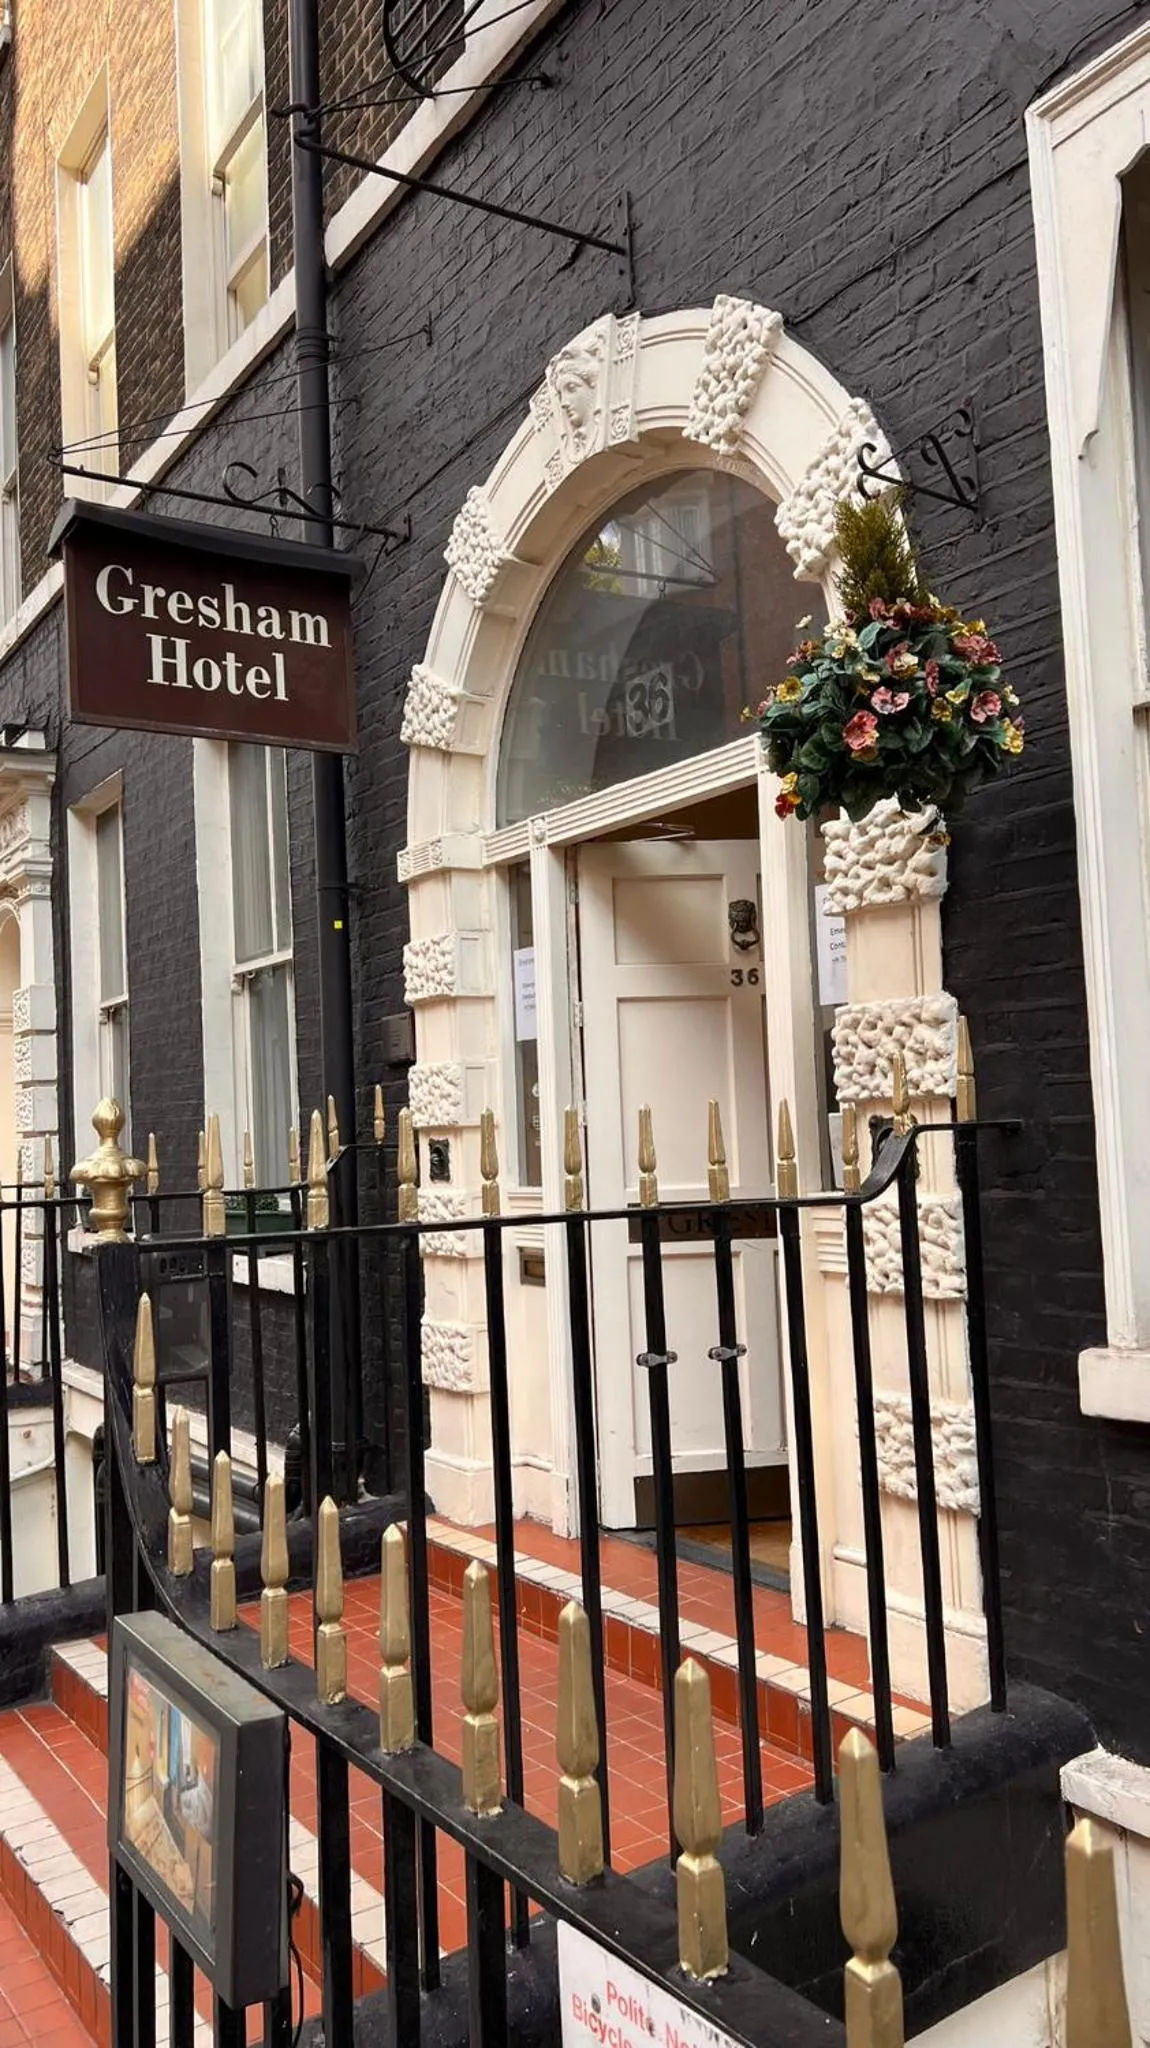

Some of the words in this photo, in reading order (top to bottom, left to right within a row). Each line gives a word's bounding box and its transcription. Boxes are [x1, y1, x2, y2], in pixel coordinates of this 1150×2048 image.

[95, 564, 332, 648] Gresham
[146, 633, 289, 701] Hotel
[627, 670, 673, 735] 36
[731, 968, 759, 987] 36
